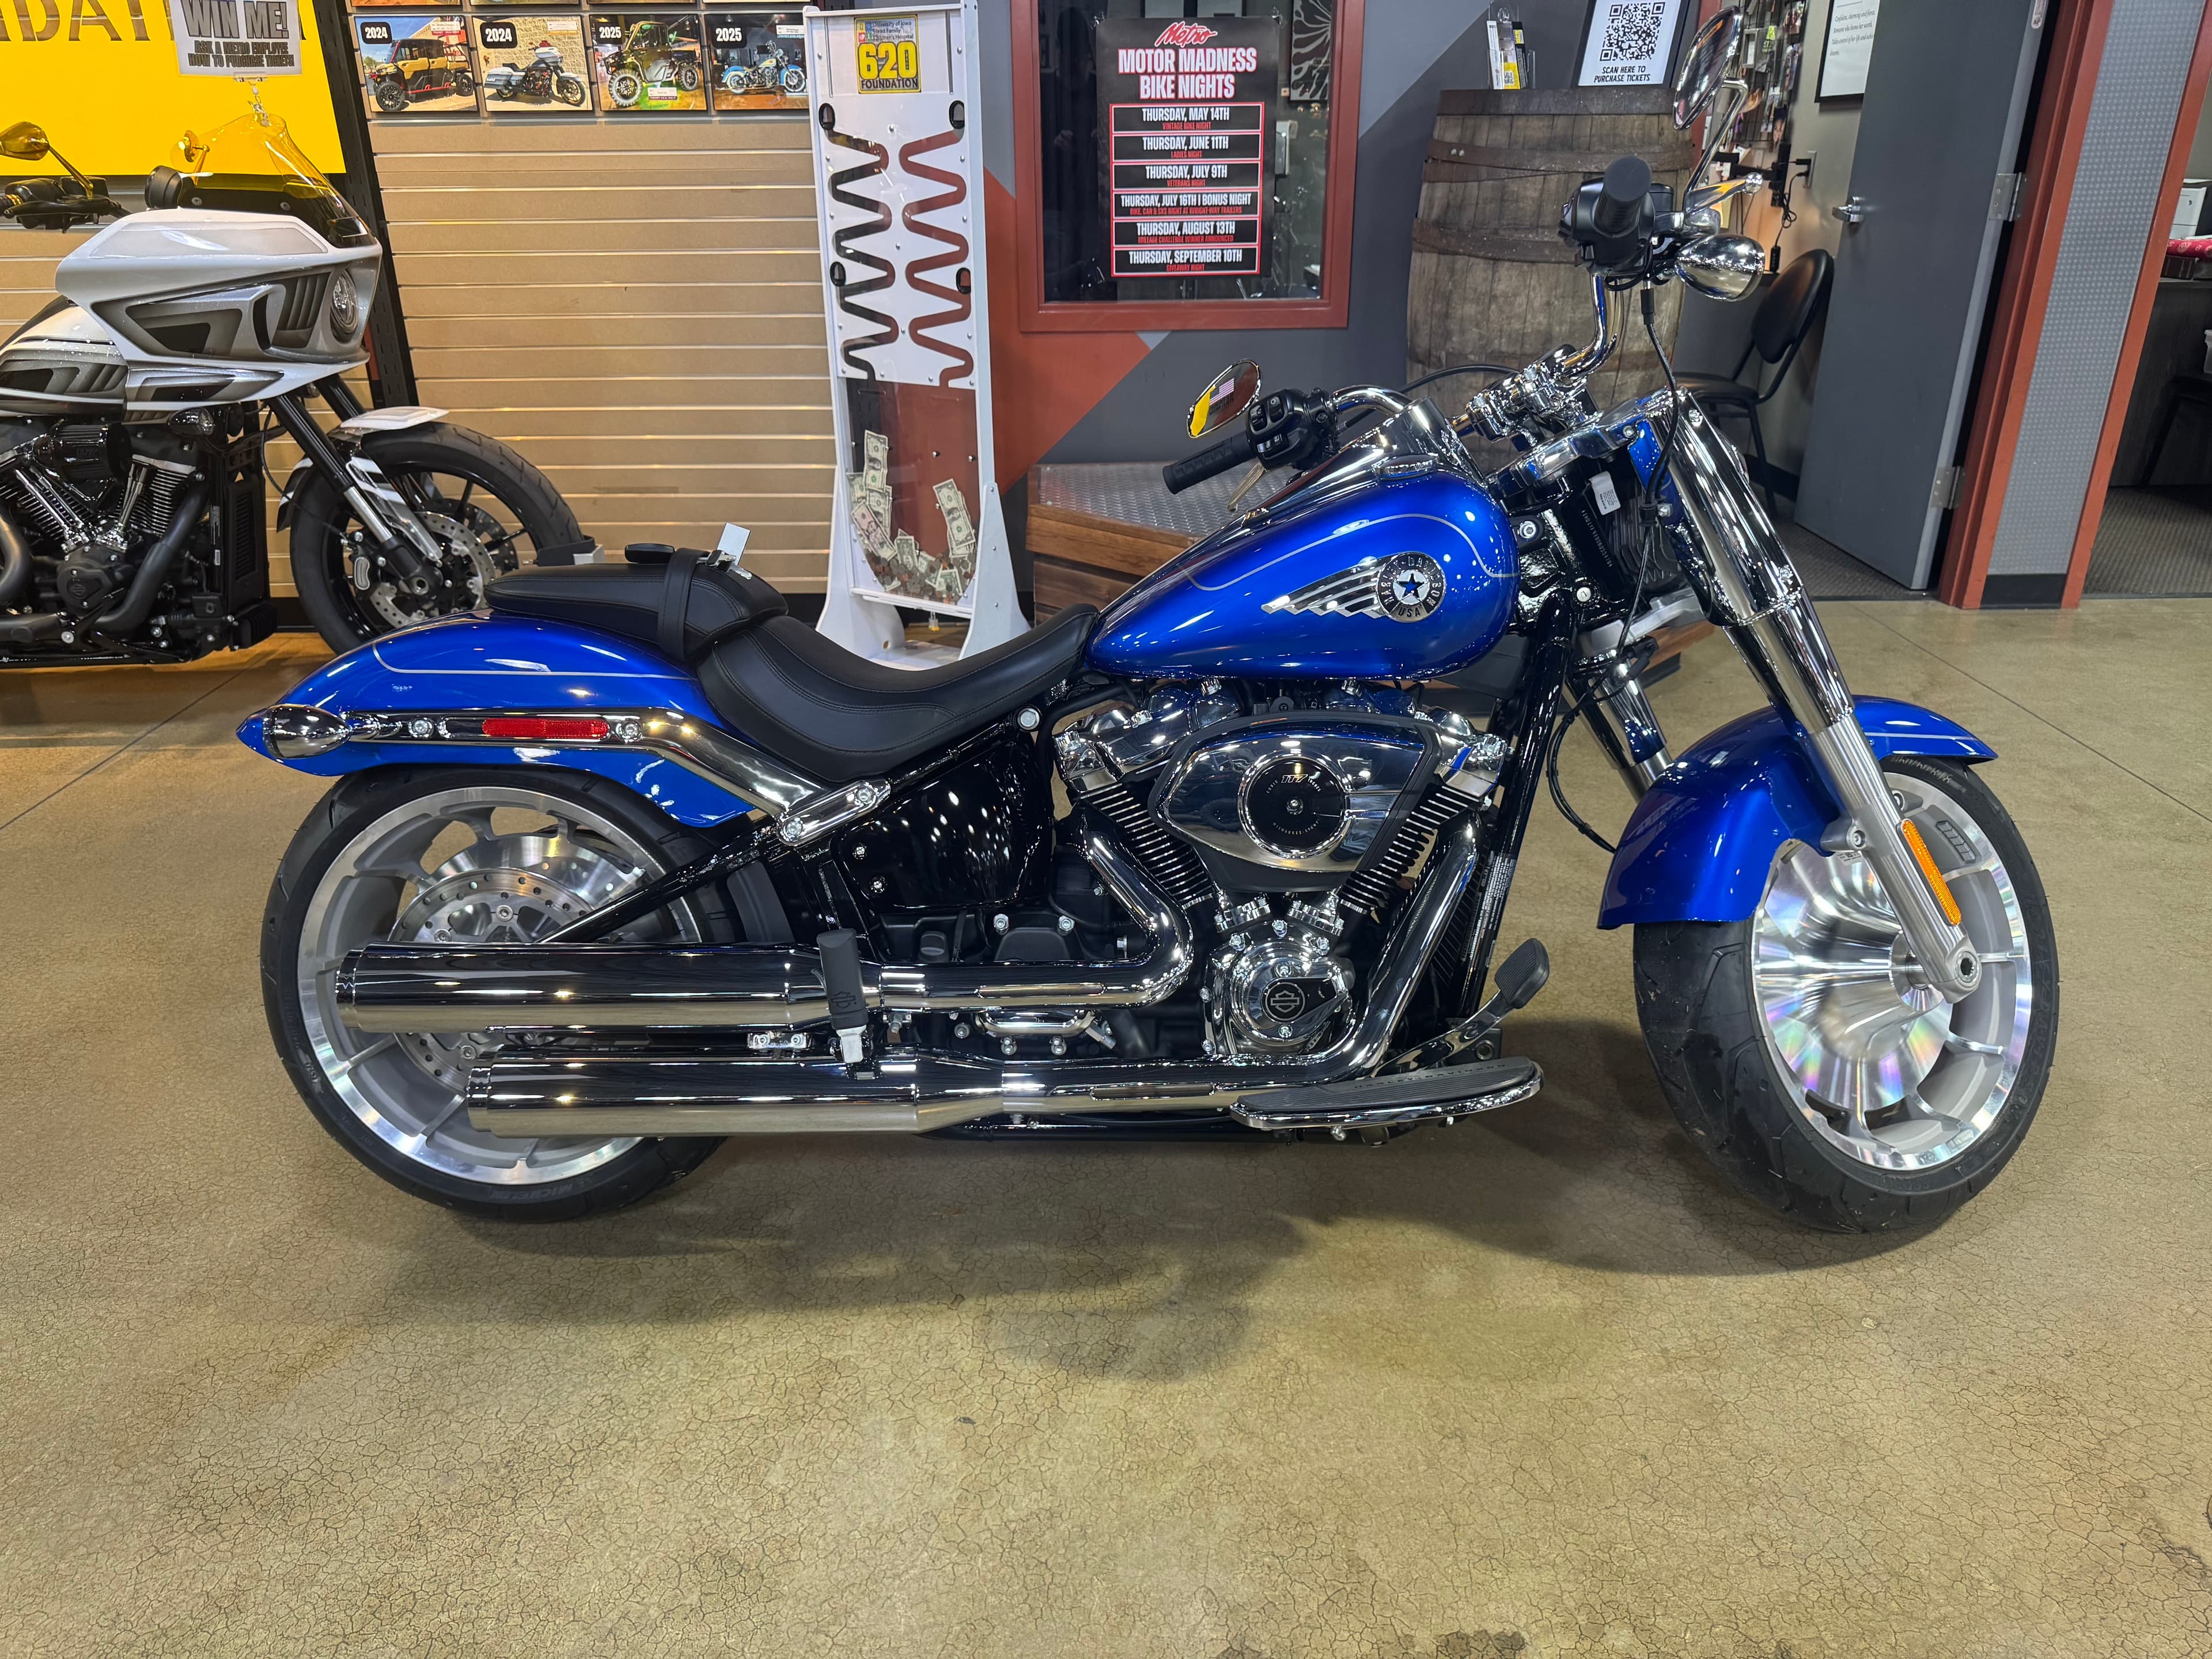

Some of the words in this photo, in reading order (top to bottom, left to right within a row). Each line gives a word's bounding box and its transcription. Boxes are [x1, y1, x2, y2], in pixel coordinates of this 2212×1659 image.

[180, 0, 240, 38] WIN
[243, 1, 289, 39] ME!
[365, 27, 388, 39] 2024
[485, 28, 512, 42] 2024
[599, 26, 622, 39] 2025
[715, 28, 742, 42] 2025
[1155, 21, 1218, 48] Metro
[194, 40, 214, 54] ASK
[215, 41, 222, 54] A
[223, 41, 250, 54] METRO
[251, 42, 289, 54] EMPLOYEE
[188, 53, 211, 66] HOW
[212, 54, 225, 67] TO
[225, 54, 264, 67] PURCHASE
[858, 40, 918, 79] 620
[1118, 48, 1176, 74] MOTOR
[1178, 47, 1257, 73] MADNESS
[861, 78, 918, 89] FOUNDATION
[1594, 74, 1624, 83] PURCHASE
[1627, 74, 1650, 82] TICKETS
[1139, 74, 1176, 99] BIKE
[1177, 74, 1235, 99] NIGHTS
[1142, 108, 1187, 122] THURSDAY,
[1189, 108, 1209, 120] MAY
[1210, 107, 1229, 120] 14TH
[1162, 122, 1183, 130] VINTAGE
[1184, 122, 1195, 130] BIKE
[1143, 137, 1187, 151] THURSDAY,
[1188, 137, 1209, 150] JUNE
[1211, 136, 1229, 149] 11TH
[1146, 165, 1190, 180] THURSDAY,
[1191, 165, 1210, 179] JULY
[1211, 165, 1228, 178] 9TH
[1121, 195, 1160, 208] THURSDAY,
[1161, 194, 1178, 206] JULY
[1179, 194, 1197, 206] 16TH
[1202, 194, 1228, 206] BONUS
[1229, 193, 1252, 205] NIGHT
[1130, 208, 1142, 216] BIKE,
[1158, 207, 1168, 215] SXS
[1221, 206, 1242, 214] TRAILERS
[1137, 223, 1181, 237] THURSDAY,
[1182, 222, 1215, 235] AUGUST
[1216, 221, 1235, 234] 13TH
[1158, 236, 1184, 244] CHALLENGE
[1129, 251, 1173, 264] THURSDAY,
[1174, 249, 1222, 263] SEPTEMBER
[1223, 249, 1243, 262] 10TH
[1398, 607, 1421, 618] USA
[1266, 779, 1279, 794] CUBIC
[1281, 774, 1308, 783] 117
[1354, 1063, 1506, 1088] HARLEY-DAVIDSON
